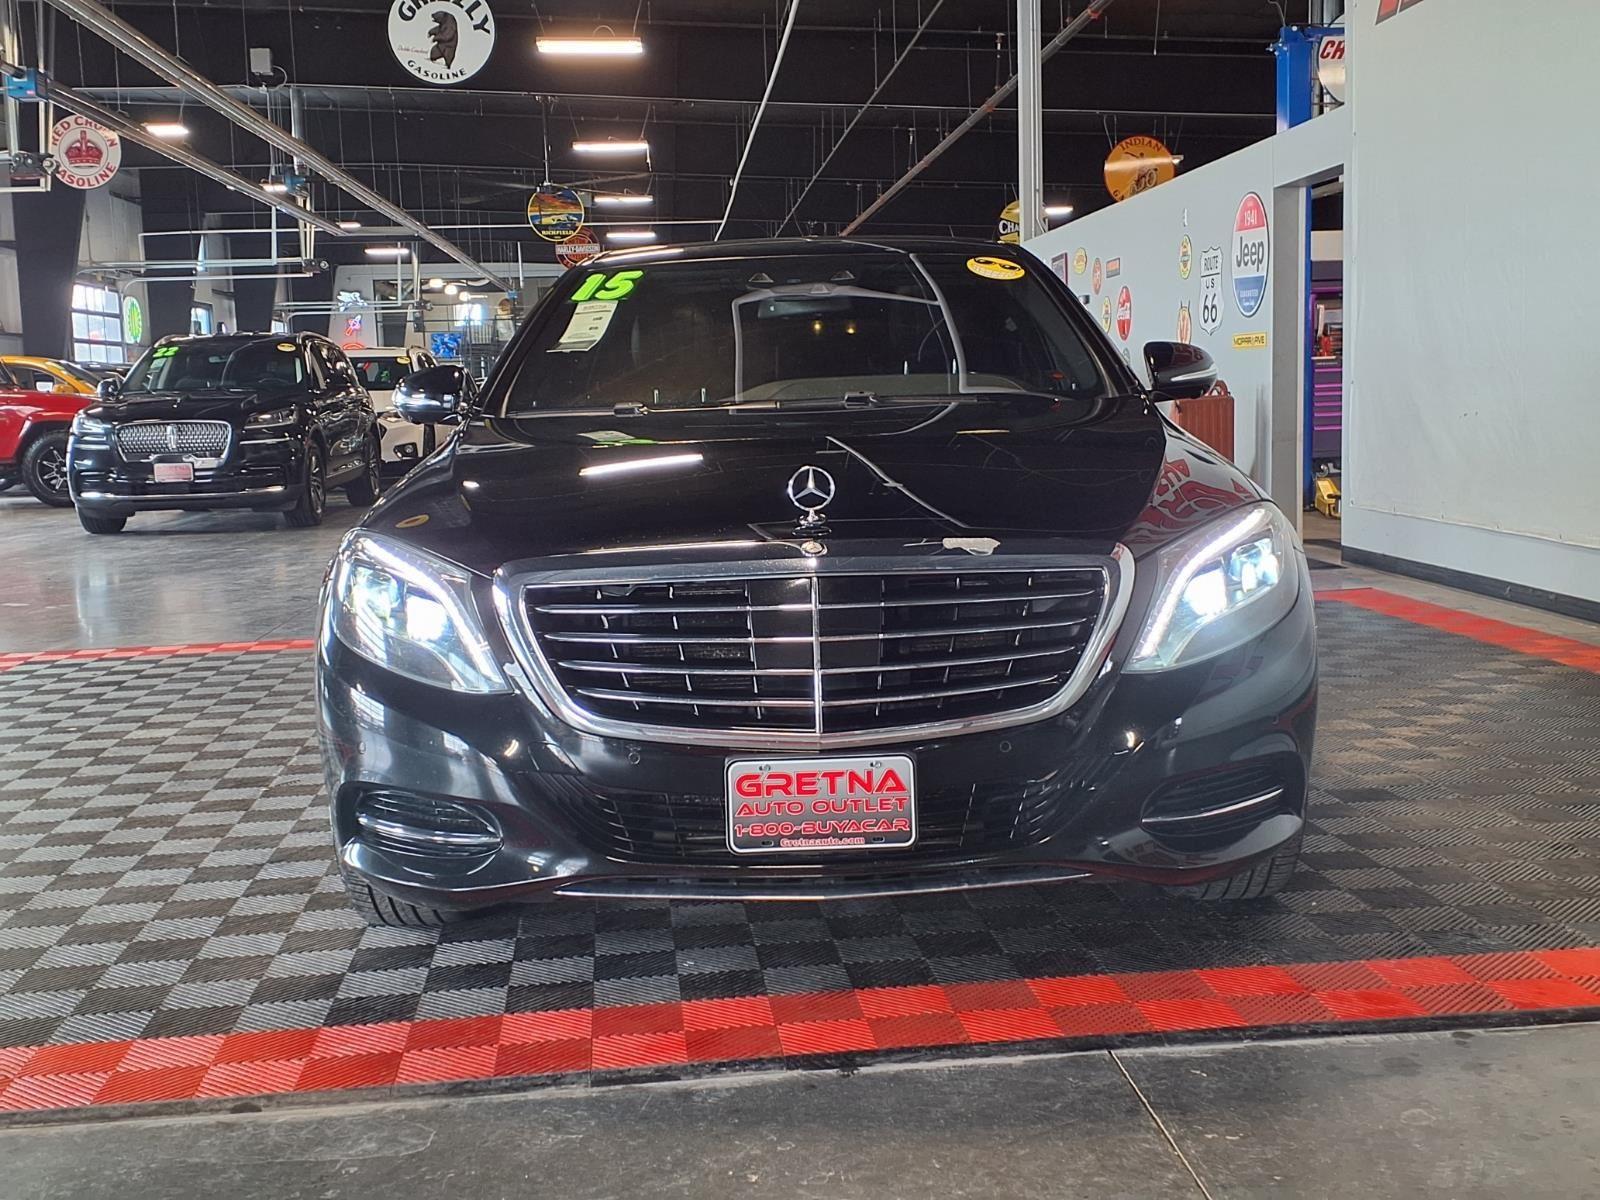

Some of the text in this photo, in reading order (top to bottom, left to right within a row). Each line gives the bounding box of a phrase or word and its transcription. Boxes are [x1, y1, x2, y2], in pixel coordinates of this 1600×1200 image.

[1320, 40, 1345, 60] CH
[407, 60, 467, 80] GASOLINE
[74, 116, 118, 148] CRON
[1120, 138, 1161, 152] INDIAN
[57, 162, 117, 187] ASOLINE
[998, 220, 1020, 234] CHA
[1244, 208, 1258, 226] 1941
[1204, 255, 1219, 271] ROUTE
[1236, 236, 1265, 272] Jeep
[571, 271, 644, 301] 15
[1202, 293, 1218, 323] 66
[153, 347, 180, 358] 22
[735, 768, 908, 798] GRETNA
[735, 797, 910, 817] AUTO OUTLET
[735, 818, 910, 837] 1-800-BUYACAR
[780, 836, 865, 848] Gretnaauto.com
